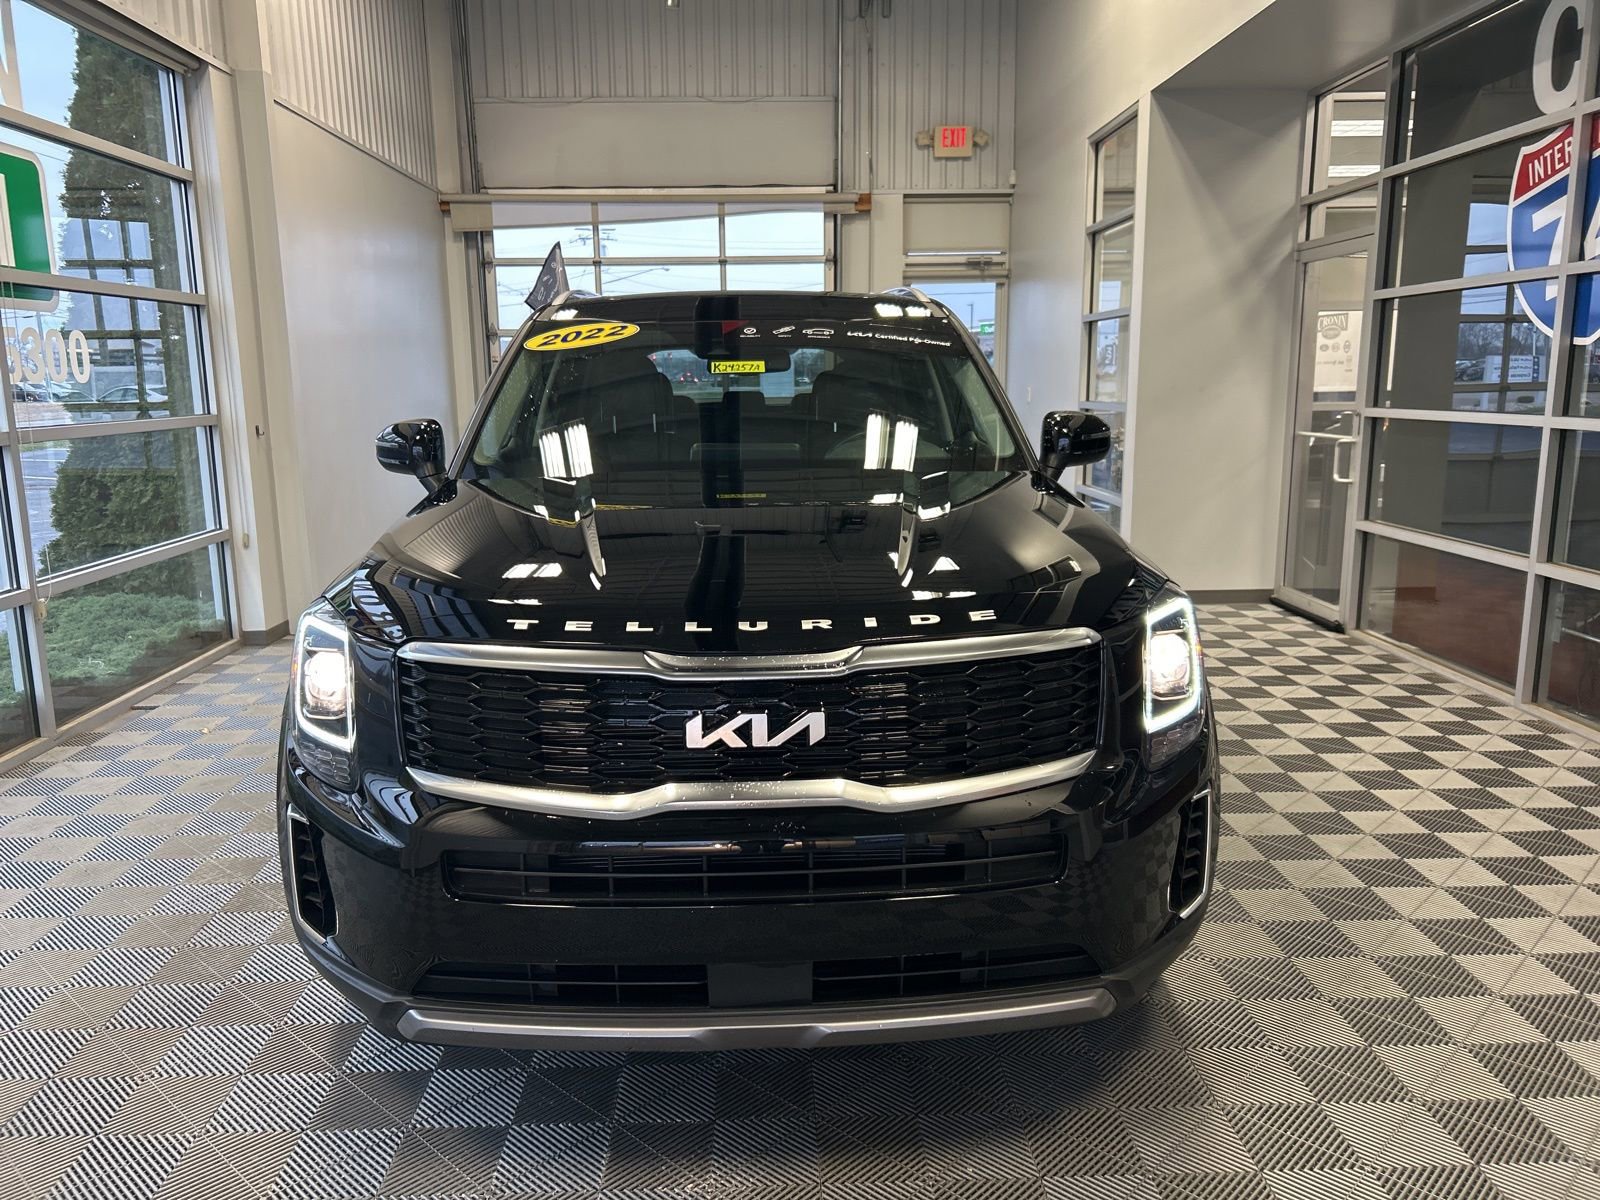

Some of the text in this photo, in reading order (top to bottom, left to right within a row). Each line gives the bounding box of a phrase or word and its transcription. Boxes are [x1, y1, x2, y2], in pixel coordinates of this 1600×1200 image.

[942, 128, 967, 148] EXIT
[1318, 314, 1347, 331] CRONIN
[536, 325, 629, 348] 2022
[875, 333, 908, 342] Certified
[713, 363, 761, 372] K24257A
[507, 610, 996, 632] TELLURIDE
[685, 711, 826, 749] KIA
